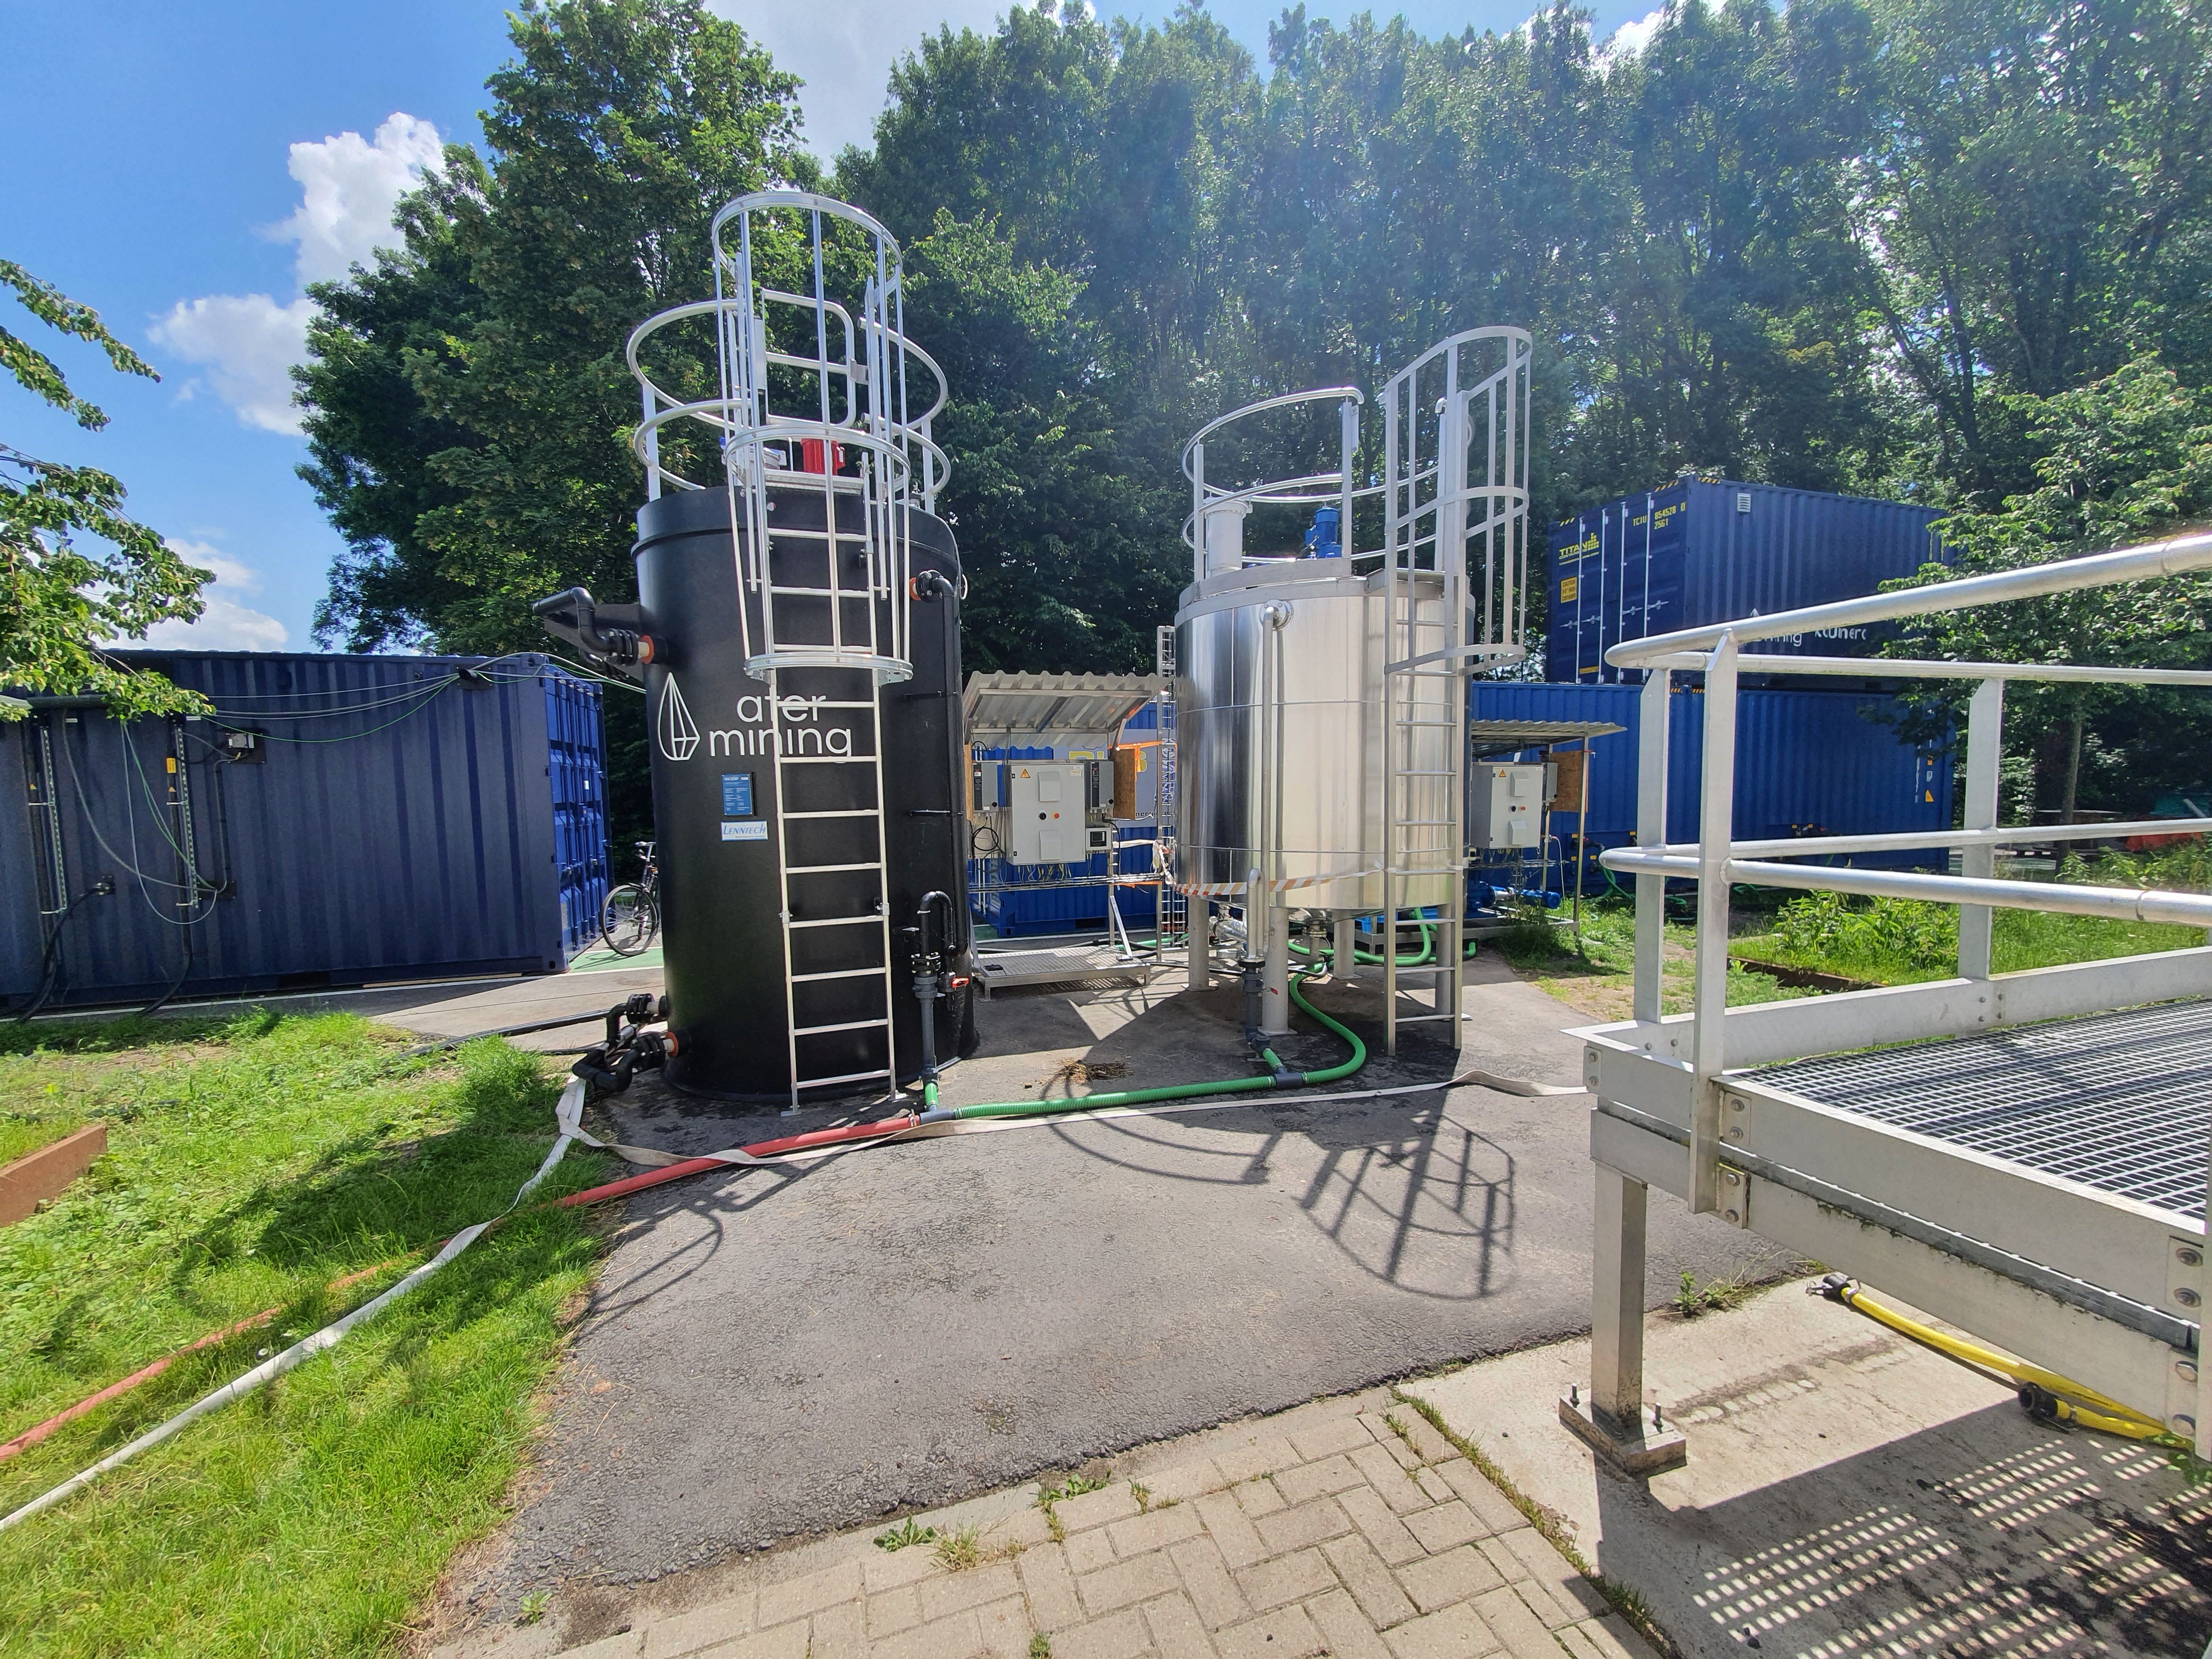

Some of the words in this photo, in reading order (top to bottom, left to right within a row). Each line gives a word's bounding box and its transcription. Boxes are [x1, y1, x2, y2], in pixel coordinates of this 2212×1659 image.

[1633, 515, 1647, 527] TCIU
[1654, 505, 1676, 520] 854528
[1654, 518, 1668, 529] 25G1
[1559, 541, 1587, 556] TITAN
[709, 728, 852, 764] mining
